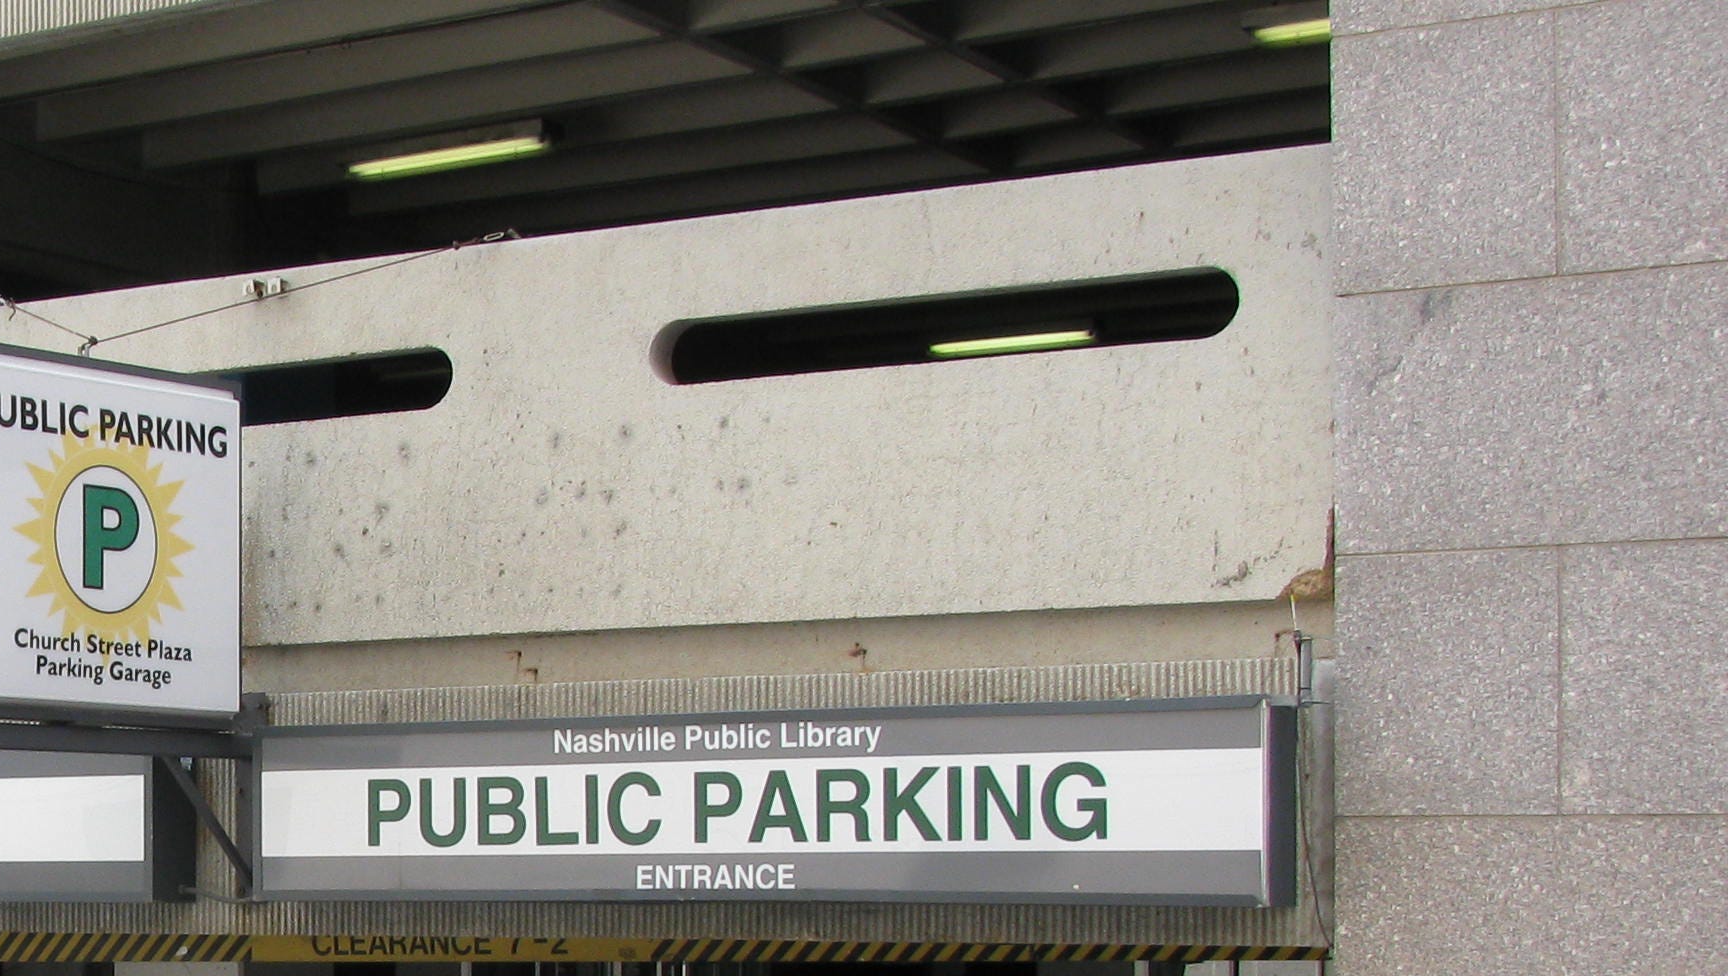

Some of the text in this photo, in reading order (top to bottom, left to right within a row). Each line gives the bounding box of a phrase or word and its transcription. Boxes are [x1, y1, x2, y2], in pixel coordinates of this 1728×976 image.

[99, 408, 228, 458] PARKING
[82, 483, 140, 590] P
[13, 627, 192, 662] Church Street Plaza
[35, 654, 171, 689] Parking Garage
[553, 719, 882, 754] Nashville Public Library
[366, 761, 1110, 848] PUBLIC PARKING
[634, 862, 796, 891] ENTRANCE
[312, 936, 491, 956] CLEARANCE
